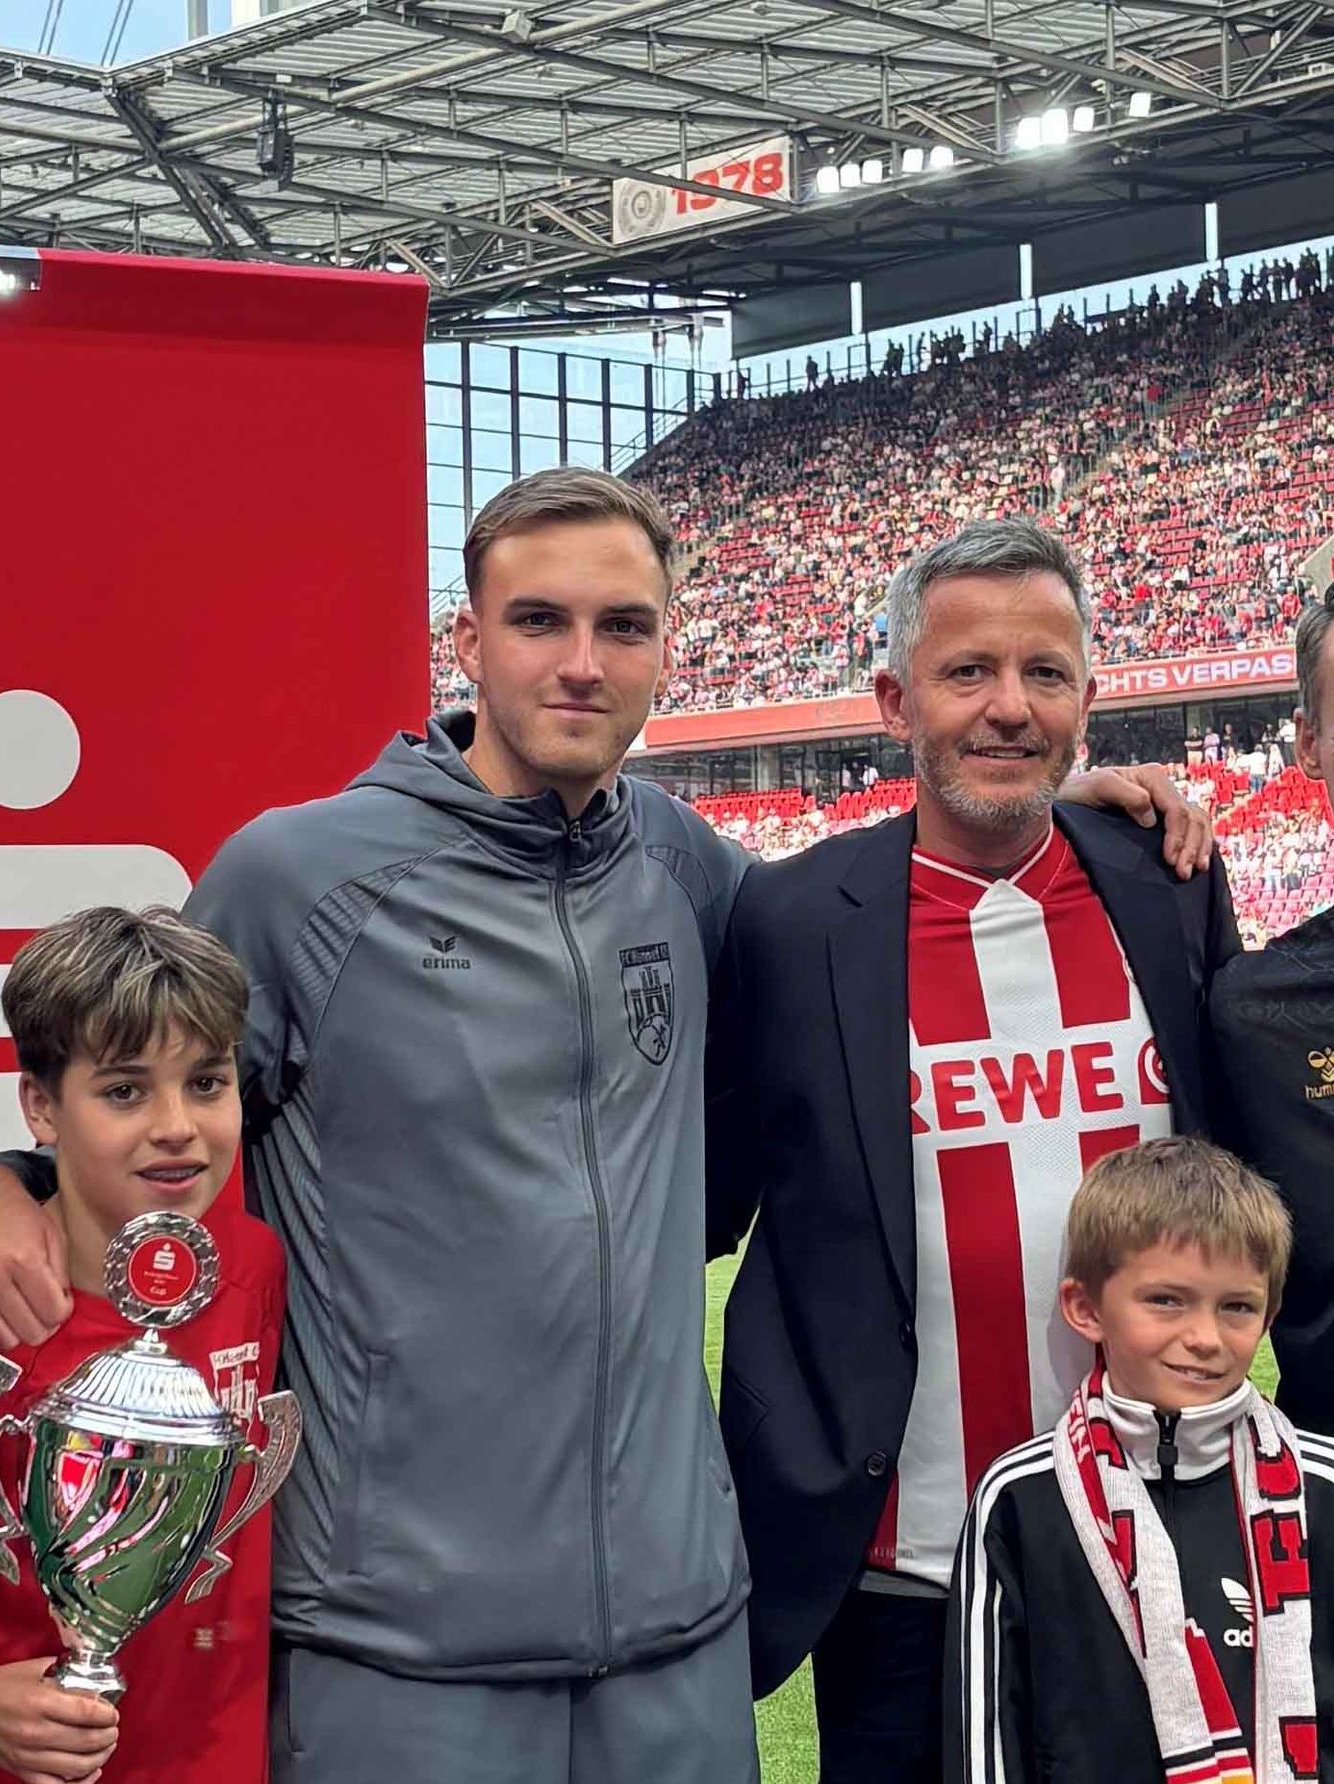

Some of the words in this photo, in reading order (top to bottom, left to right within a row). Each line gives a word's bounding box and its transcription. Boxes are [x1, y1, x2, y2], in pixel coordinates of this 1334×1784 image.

[672, 152, 784, 215] 1978
[1172, 653, 1293, 687] VERPAS
[422, 958, 471, 970] erima
